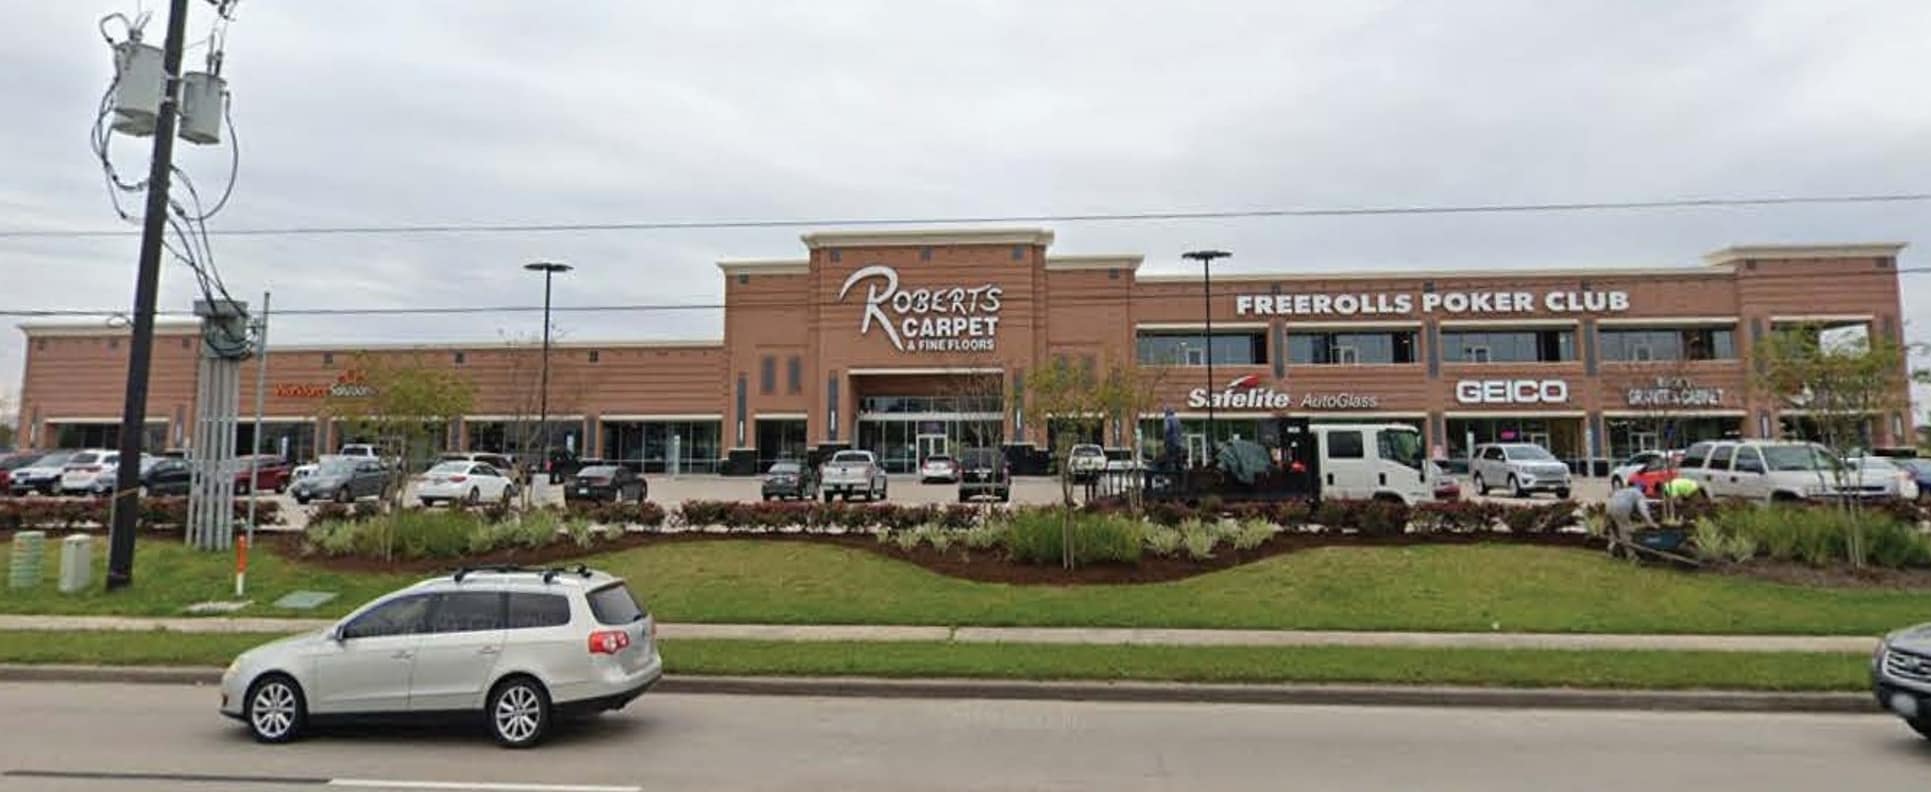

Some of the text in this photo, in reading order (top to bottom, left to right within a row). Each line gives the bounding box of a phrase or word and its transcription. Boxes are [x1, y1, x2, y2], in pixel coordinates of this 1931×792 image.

[839, 265, 1003, 351] ROBERTS
[1237, 291, 1630, 315] FREEROLLS POKER CLUB
[902, 317, 998, 337] CARPET
[919, 339, 946, 350] FINE
[948, 339, 994, 350] FLOORS
[1187, 387, 1377, 408] Safelite AutoGlass
[1456, 379, 1568, 403] GEICO
